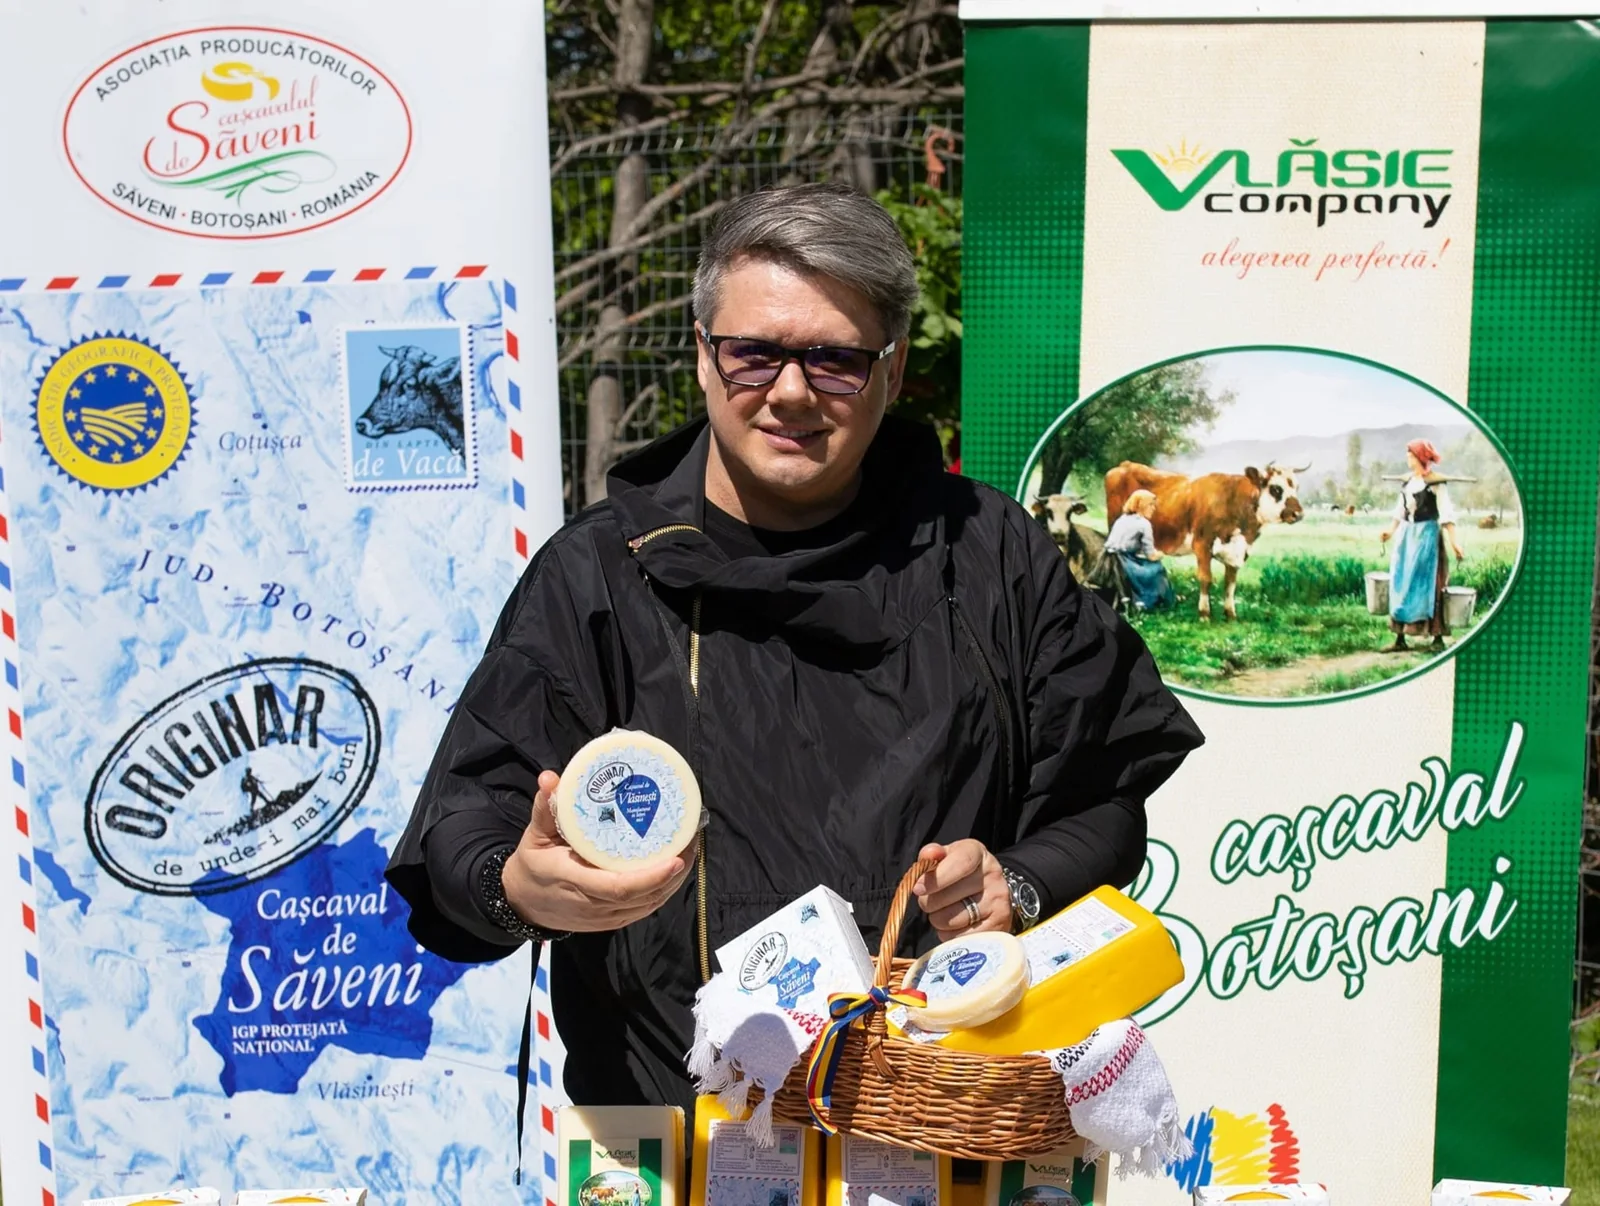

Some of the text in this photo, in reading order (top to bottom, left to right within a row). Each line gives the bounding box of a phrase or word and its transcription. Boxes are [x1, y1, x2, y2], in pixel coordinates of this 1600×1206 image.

[200, 38, 378, 96] PRODUCĂTORILOR
[165, 140, 190, 173] de
[1110, 138, 1454, 212] VLĂSIE
[112, 171, 380, 231] SĂVENI BOTOȘANI ROMÂNIA
[1203, 193, 1452, 229] company
[1201, 237, 1311, 281] alegerea
[354, 447, 462, 477] de Vacă
[365, 439, 440, 449] DIN LAPTE
[137, 549, 229, 591] JUD.
[105, 682, 326, 840] ORIGINAR
[589, 766, 625, 794] ORIGINAR
[153, 740, 358, 877] de unde-i mai bun
[1210, 720, 1527, 892] cașcaval
[256, 881, 388, 926] Cașcaval
[322, 923, 357, 955] de
[228, 943, 426, 1014] Săveni
[232, 1019, 349, 1040] IGP PROTEJATĂ
[233, 1039, 315, 1058] NAȚIONAL
